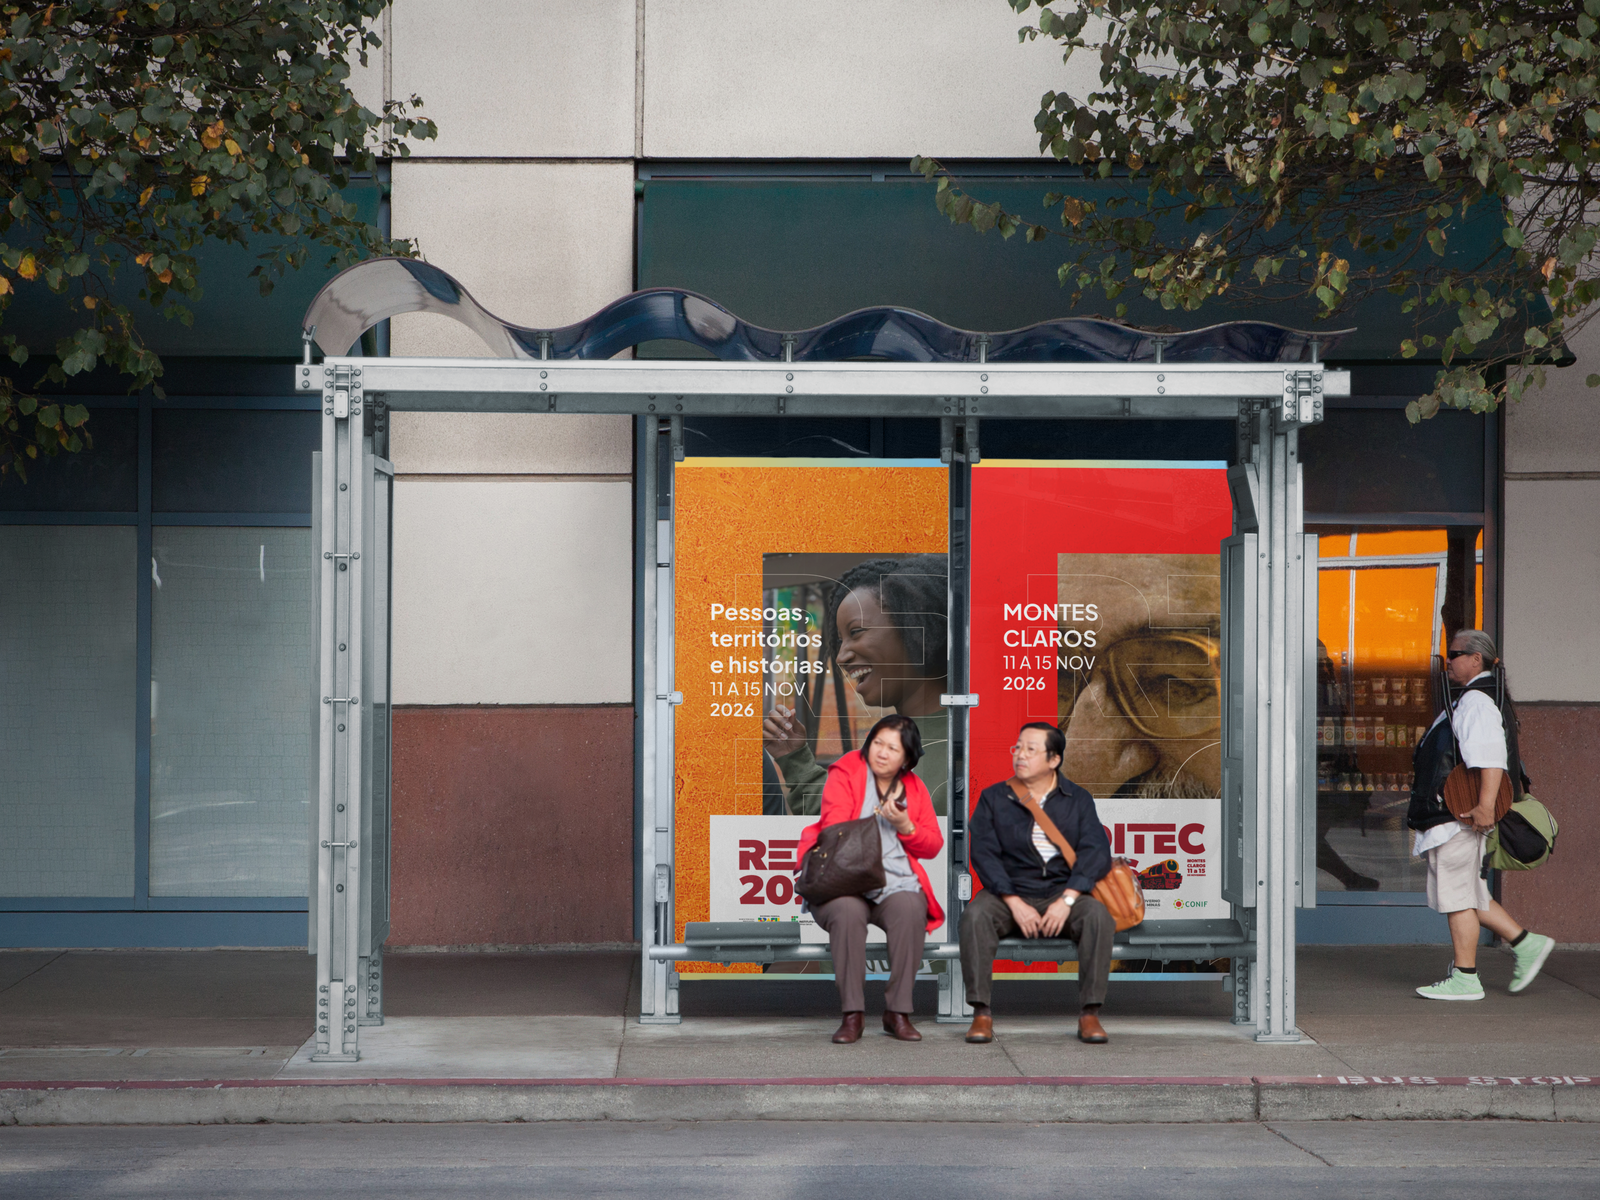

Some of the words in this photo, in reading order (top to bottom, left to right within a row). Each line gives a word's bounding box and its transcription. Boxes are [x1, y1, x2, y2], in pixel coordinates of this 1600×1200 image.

[710, 603, 810, 625] Pessoas,
[1003, 603, 1099, 622] MONTES
[710, 628, 823, 648] territórios
[1003, 629, 1097, 648] CLAROS
[710, 659, 724, 674] e
[729, 654, 831, 674] histórias.
[1003, 655, 1015, 670] 11
[1019, 655, 1032, 670] A
[1035, 655, 1052, 670] 15
[1056, 655, 1096, 670] NOV
[710, 681, 723, 696] 11
[727, 681, 740, 696] A
[743, 681, 761, 696] 15
[764, 681, 806, 697] NOV
[1003, 676, 1046, 691] 2026
[710, 702, 755, 717] 2026
[1103, 822, 1206, 855] ITEC
[1184, 900, 1208, 908] CONIF
[1336, 1076, 1439, 1085] BUS
[1468, 1076, 1591, 1085] STOP
